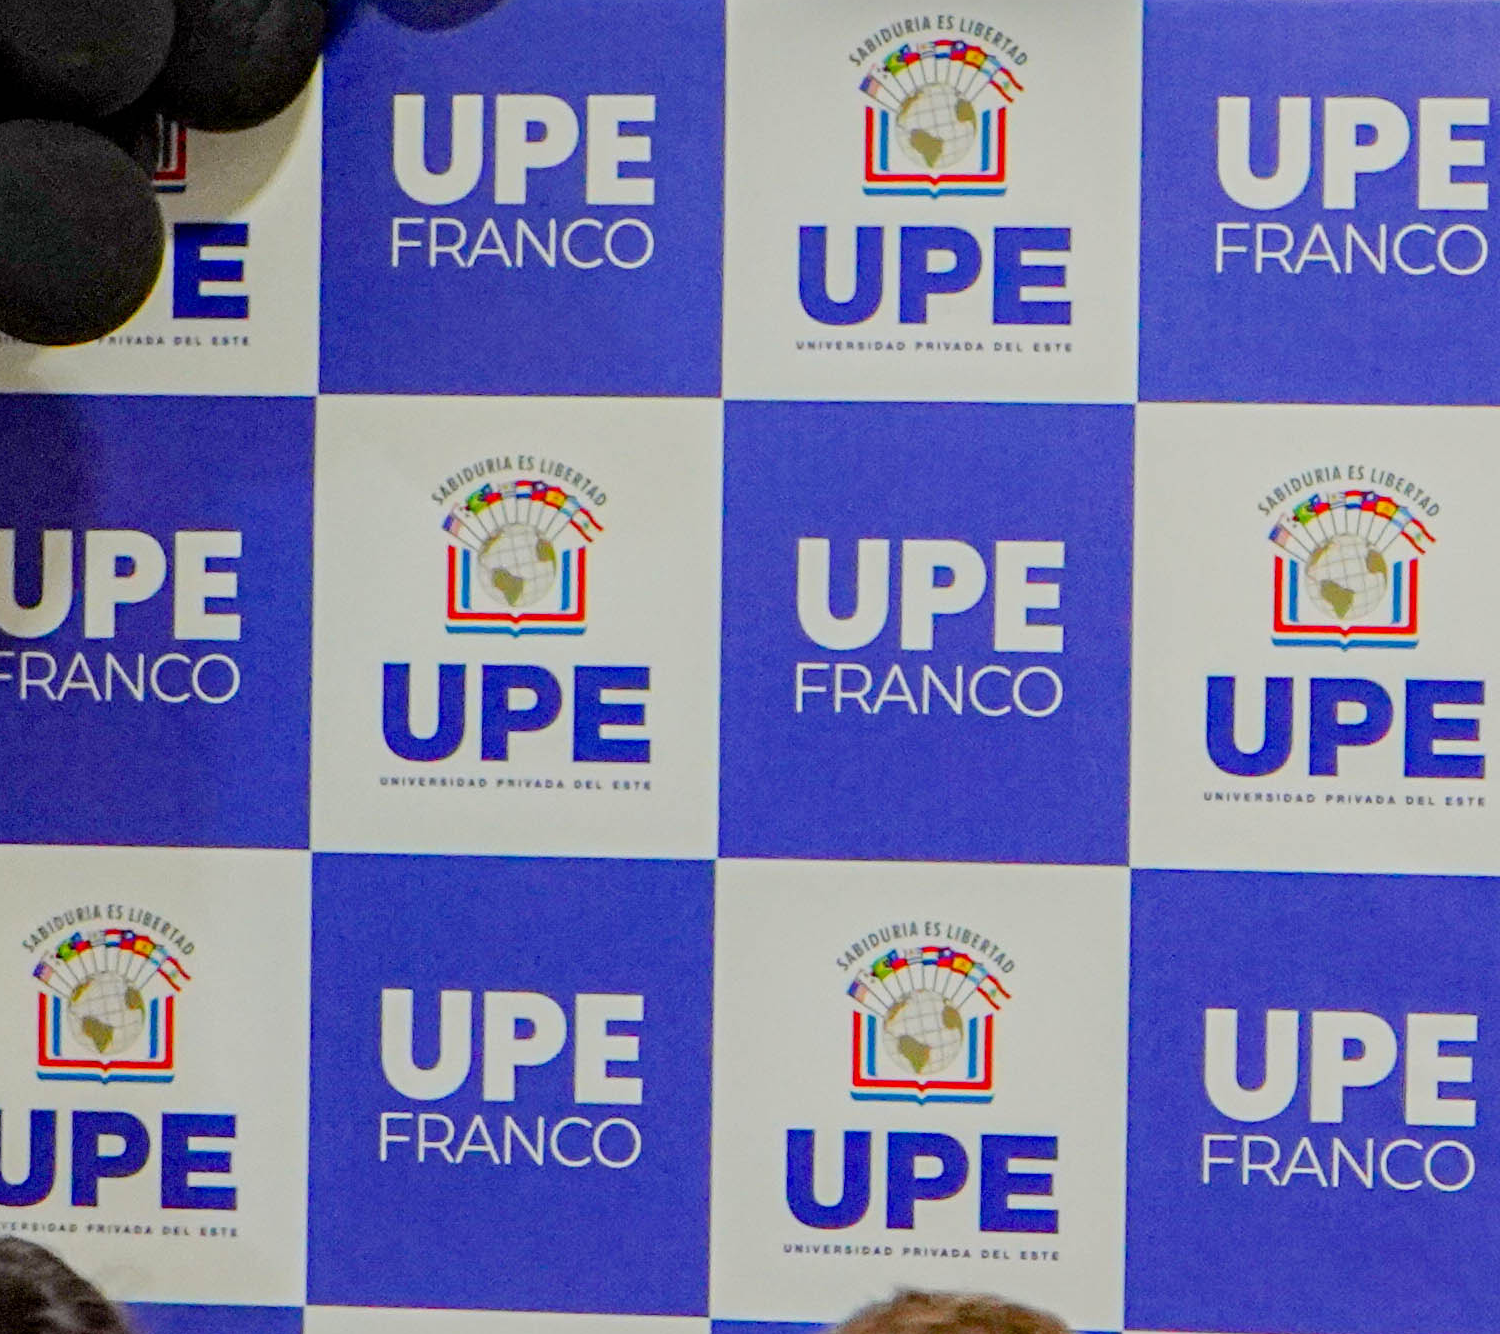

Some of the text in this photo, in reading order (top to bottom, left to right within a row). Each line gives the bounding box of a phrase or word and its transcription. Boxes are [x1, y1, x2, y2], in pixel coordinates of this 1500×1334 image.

[848, 14, 1028, 67] SABIDURIA ES LIBERTAD
[394, 94, 655, 205] UPE
[1218, 96, 1489, 210] UPE
[392, 218, 654, 269] FRANCO
[1216, 223, 1488, 275] FRANCO
[799, 226, 1071, 325] UPE
[795, 340, 1072, 353] UNIVERSIDAD PRIVADA DEL ESTE
[1257, 464, 1440, 517] SABIDURIA ES LIBERTAD
[797, 538, 1064, 652] UPE
[383, 663, 650, 763] UPE
[796, 663, 1063, 717] FRANCO
[1206, 676, 1485, 779] UPE
[1203, 791, 1485, 808] UNIVERSIDAD PRIVADA DEL ESTE
[836, 920, 1015, 974] SABIDURIA ES LIBERTAD
[381, 989, 644, 1104] UPE
[1205, 1009, 1477, 1126] UPE
[380, 1112, 641, 1168] FRANCO
[1203, 1134, 1475, 1191] FRANCO
[786, 1129, 1058, 1234] UPE
